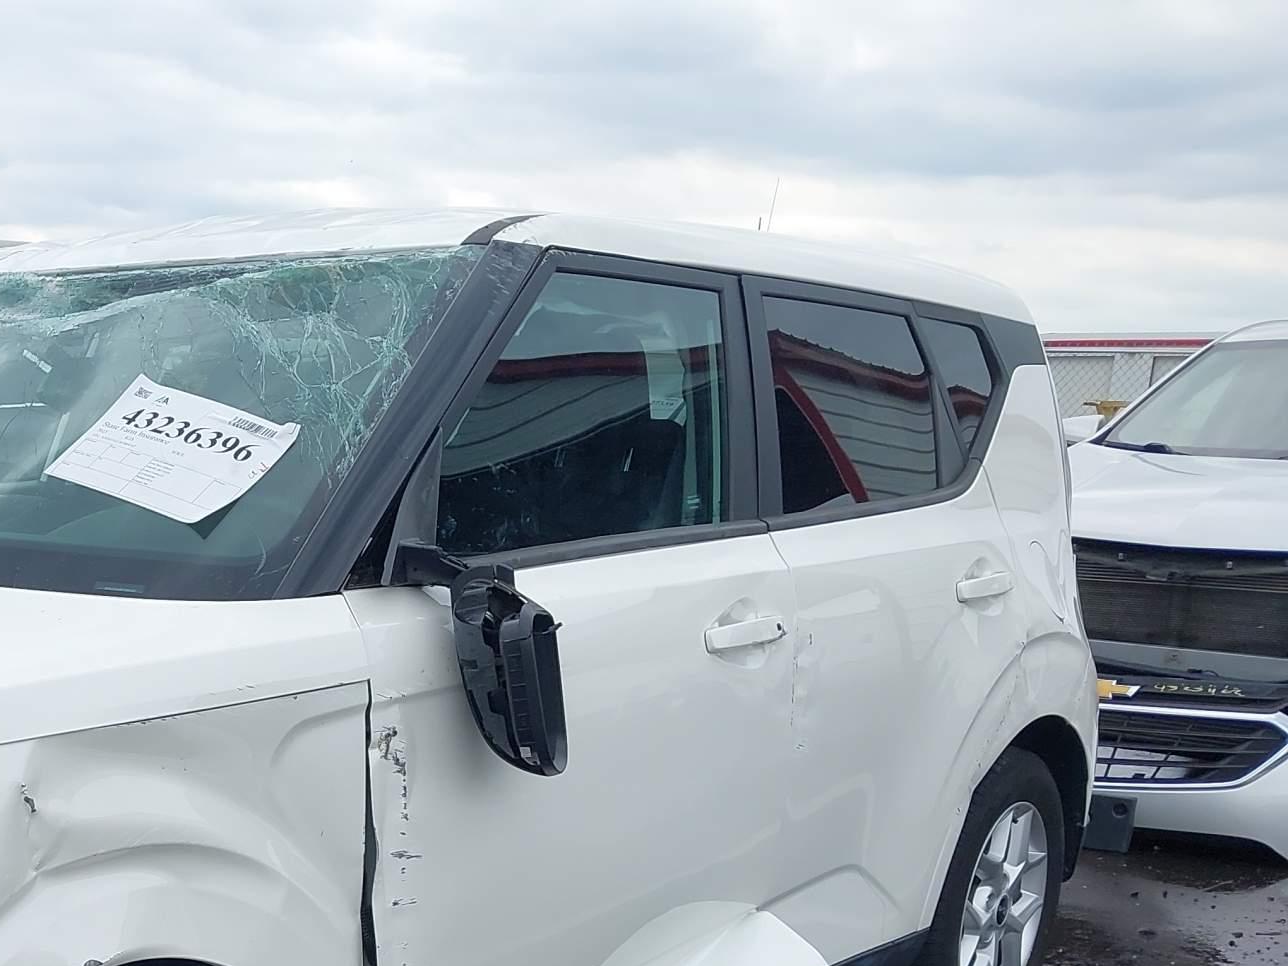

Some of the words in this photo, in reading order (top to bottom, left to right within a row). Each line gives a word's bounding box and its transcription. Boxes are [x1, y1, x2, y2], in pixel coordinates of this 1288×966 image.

[103, 421, 120, 433] State
[120, 425, 138, 436] Farm
[138, 431, 171, 446] Insurance
[121, 408, 261, 462] 43236396
